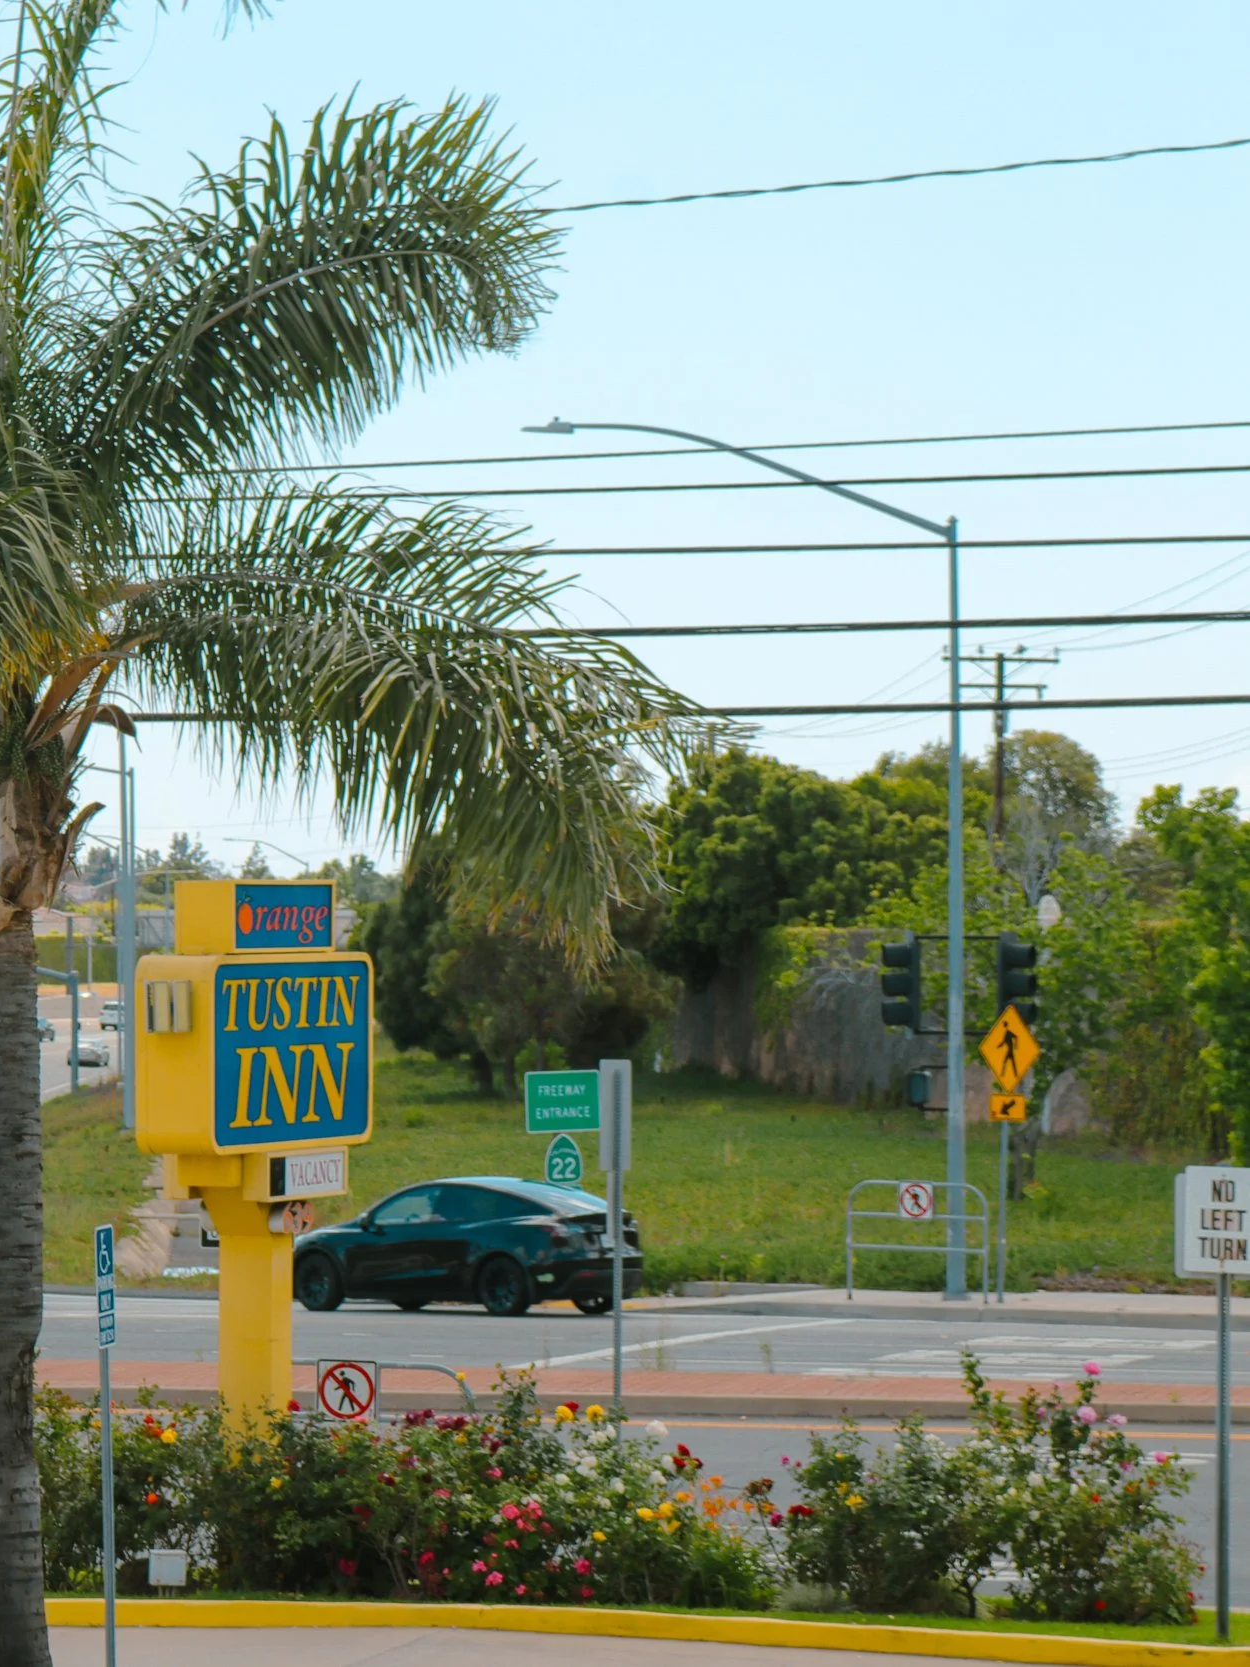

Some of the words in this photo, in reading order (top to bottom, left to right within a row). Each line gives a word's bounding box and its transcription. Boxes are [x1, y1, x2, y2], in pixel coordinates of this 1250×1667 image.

[237, 893, 328, 944] Orange
[222, 975, 361, 1032] TUSTIN
[229, 1042, 356, 1129] INN
[537, 1084, 587, 1097] FREEWAY
[535, 1106, 591, 1120] ENTRANCE
[290, 1158, 342, 1187] VACANCY
[551, 1157, 578, 1179] 22
[1212, 1179, 1236, 1203] NO
[1201, 1208, 1247, 1232] LEFT
[1198, 1236, 1247, 1260] TURN
